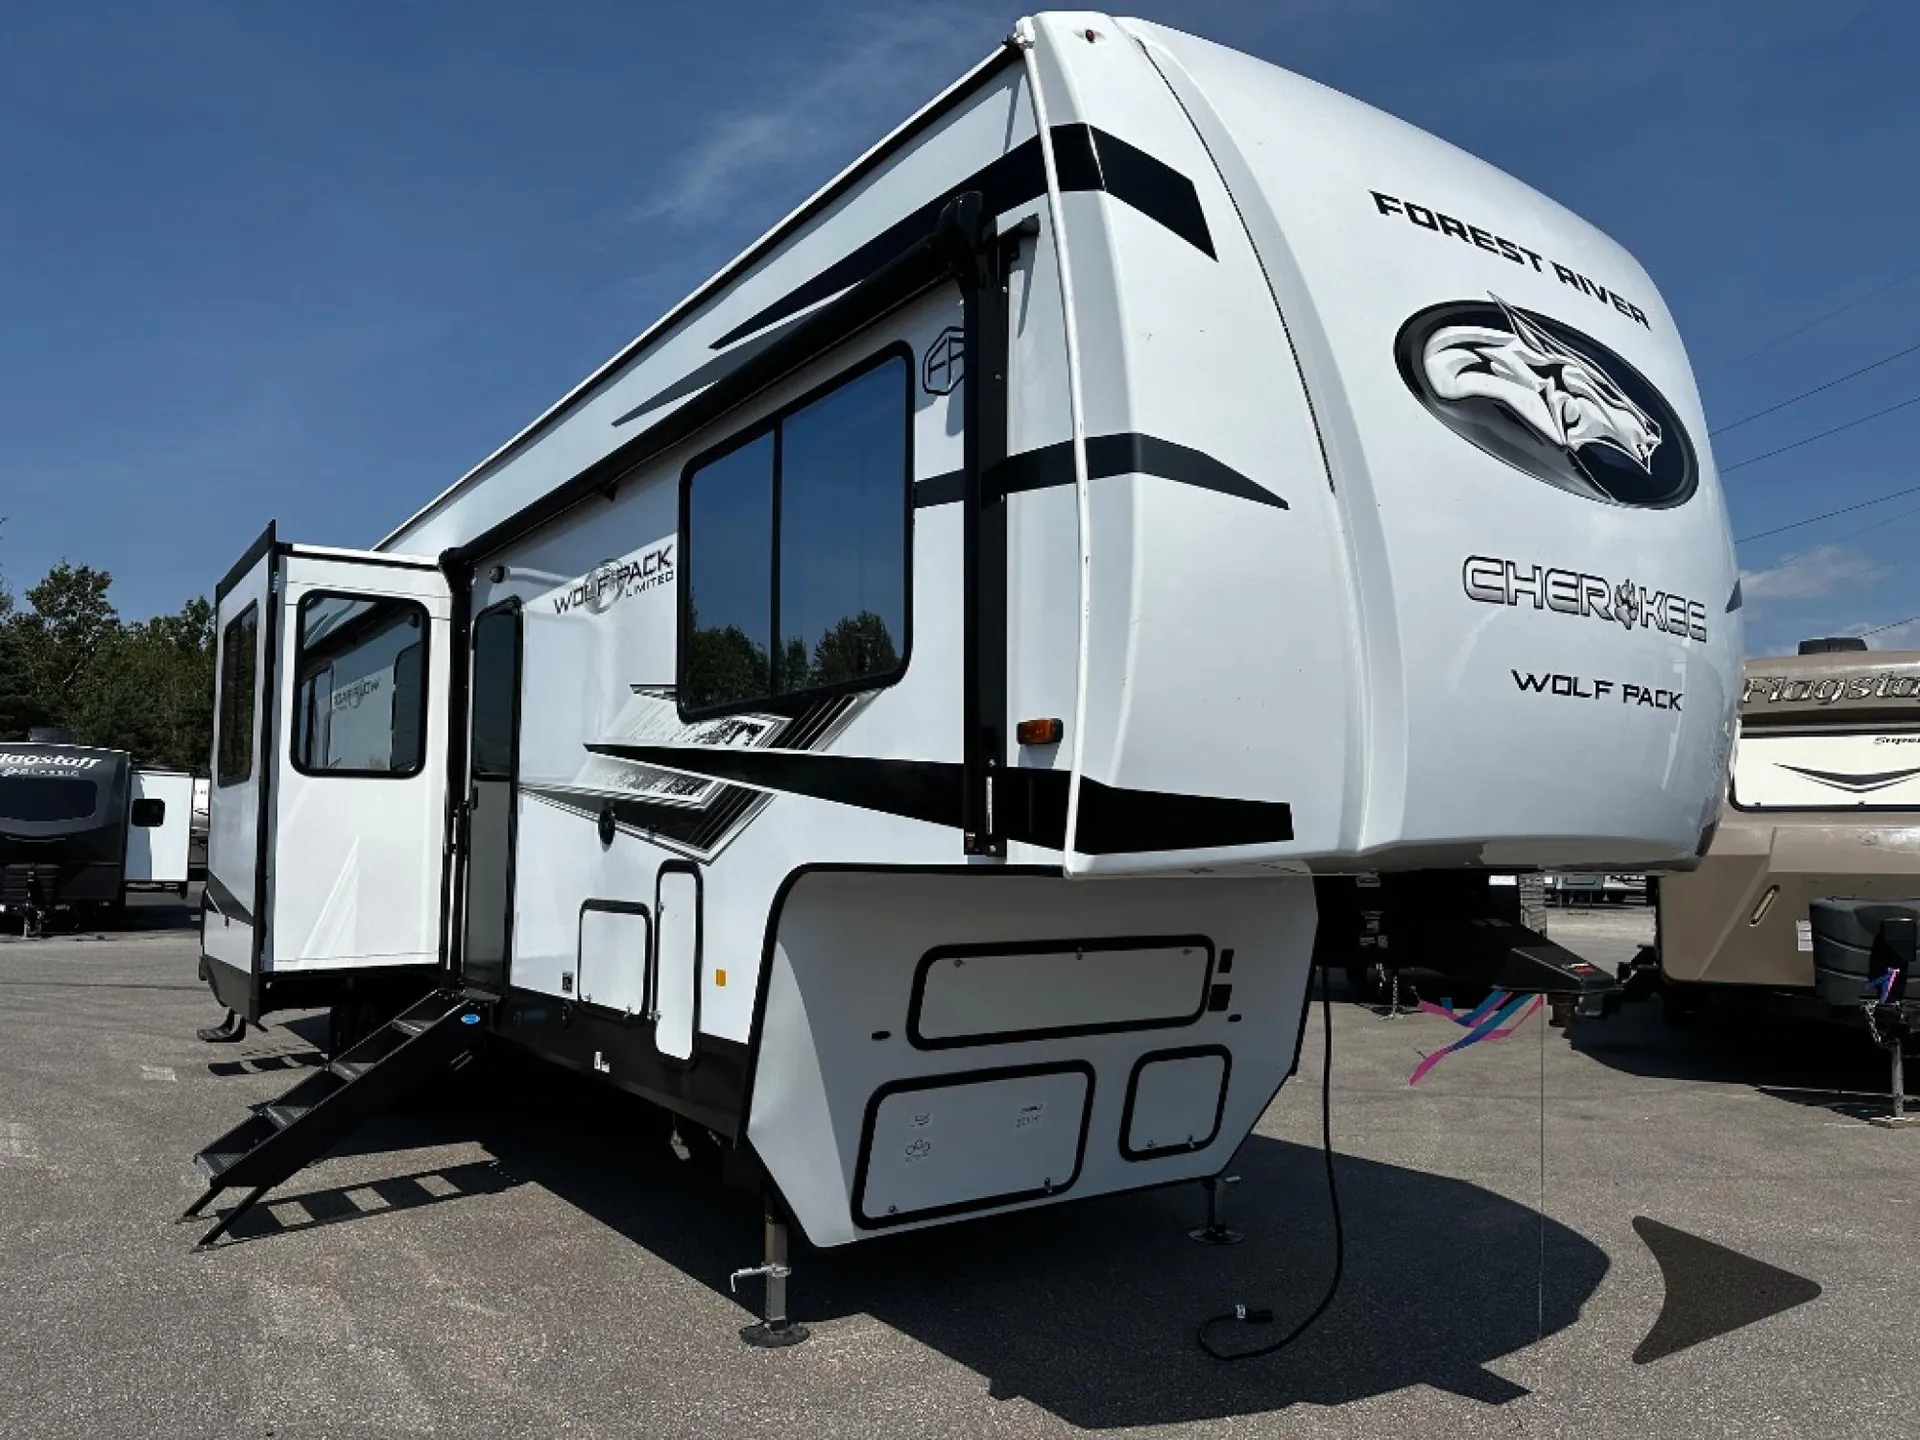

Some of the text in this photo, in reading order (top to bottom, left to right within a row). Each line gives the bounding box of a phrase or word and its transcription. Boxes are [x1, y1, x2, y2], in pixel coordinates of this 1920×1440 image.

[1367, 189, 1652, 331] FOREST RIVER
[553, 544, 674, 615] WOLF PACK
[625, 569, 674, 599] LIMITED
[1510, 668, 1683, 712] WOLF PACK
[1742, 671, 1920, 706] Flagsta
[0, 753, 102, 770] lagstaff
